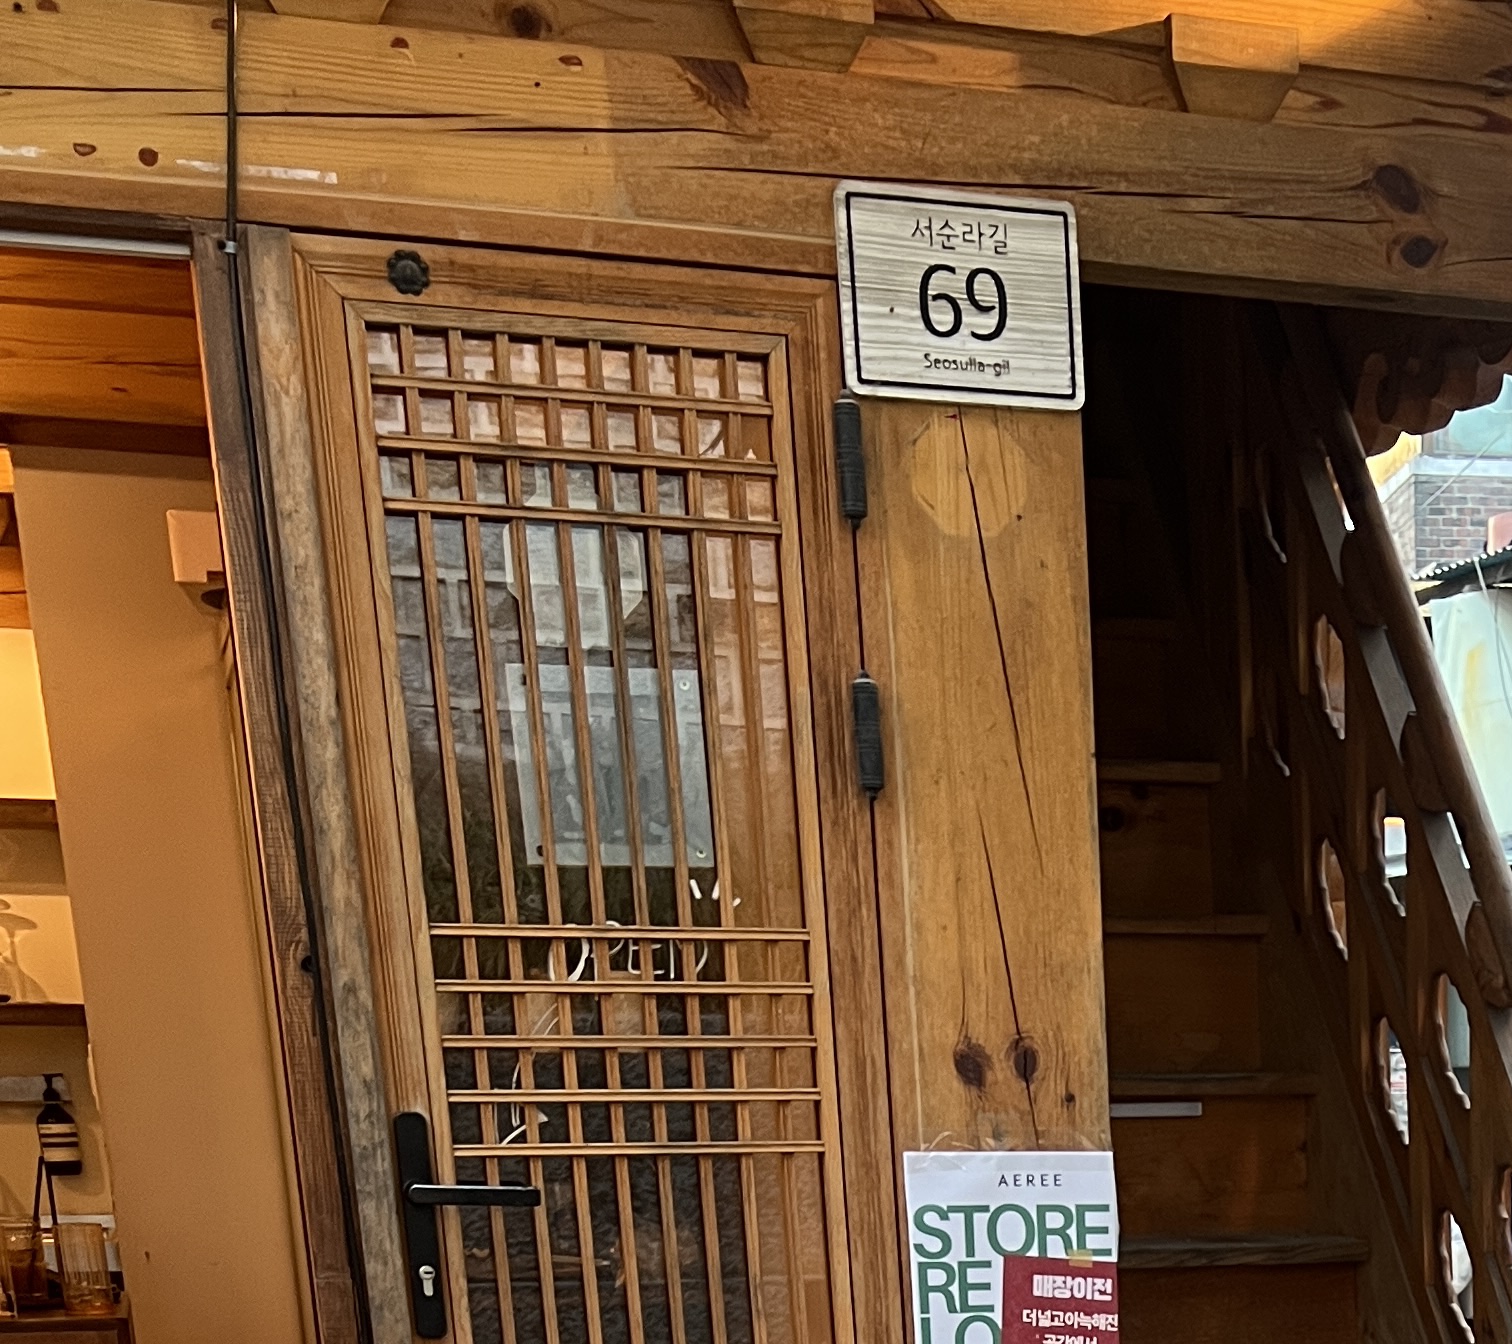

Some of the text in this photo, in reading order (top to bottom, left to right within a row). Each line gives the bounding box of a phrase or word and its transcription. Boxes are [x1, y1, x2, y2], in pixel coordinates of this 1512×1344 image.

[911, 216, 1008, 255] 서순라길
[918, 263, 1008, 342] 69
[923, 353, 1010, 377] Seosulla-gil
[998, 1174, 1062, 1187] AEREE
[913, 1203, 1113, 1260] STORE
[918, 1261, 995, 1315] RE
[1033, 1274, 1112, 1301] 매장이전
